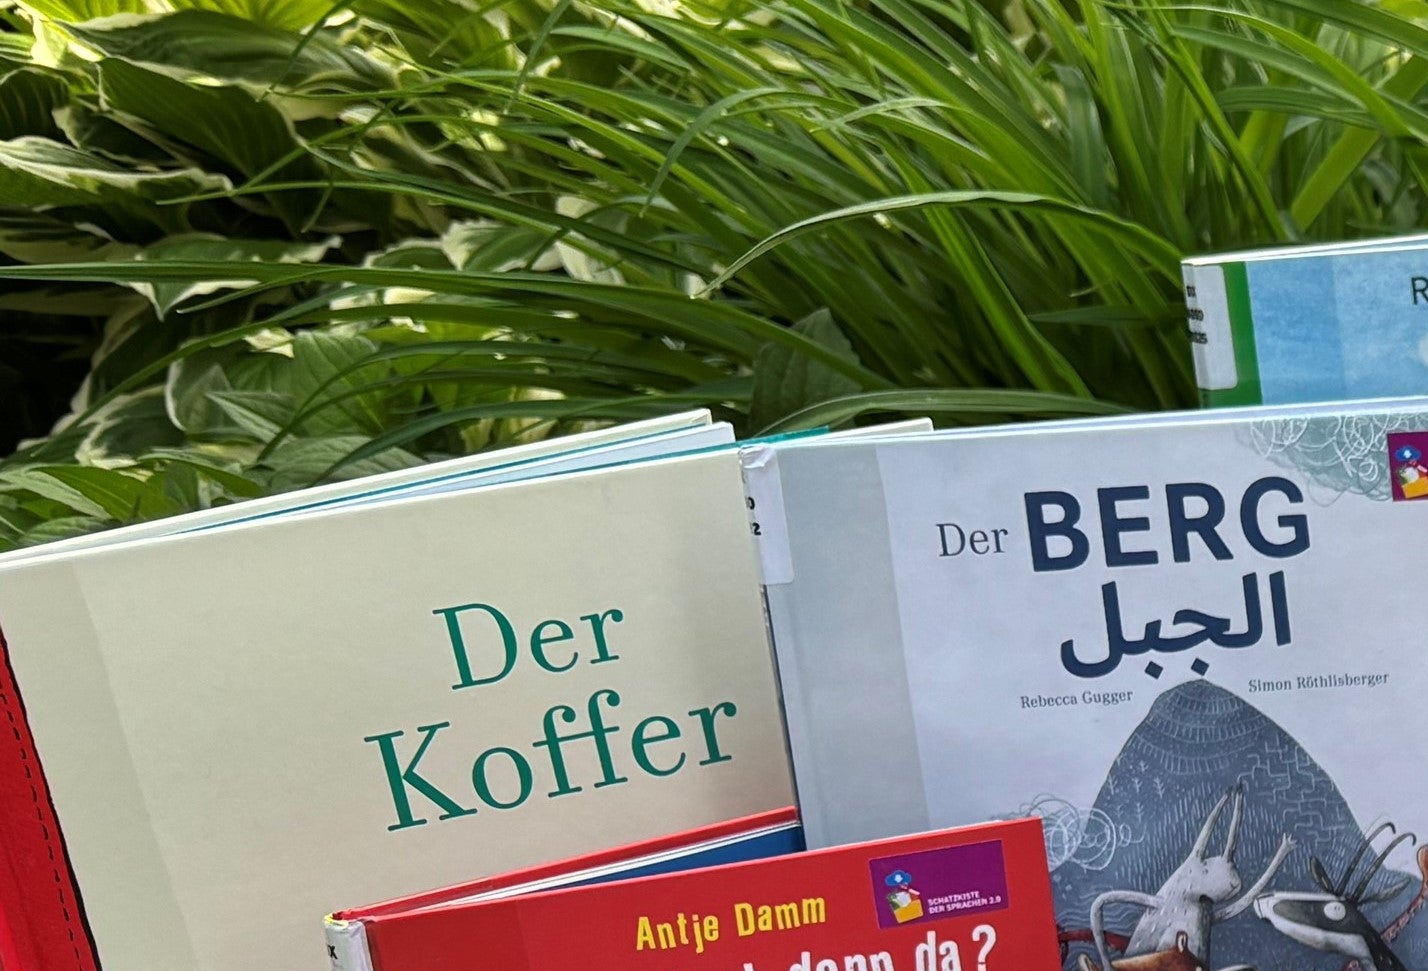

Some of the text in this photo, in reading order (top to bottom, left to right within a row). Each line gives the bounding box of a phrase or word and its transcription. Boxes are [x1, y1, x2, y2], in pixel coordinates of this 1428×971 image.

[937, 475, 1311, 572] Der BERG
[433, 602, 624, 690] Der
[1060, 572, 1293, 680] الجبل
[1020, 689, 1133, 709] Rebecca Gugger
[1248, 672, 1389, 693] Simon Röthlisberger
[364, 689, 738, 832] Koffer
[637, 896, 827, 956] Antje Damm
[928, 891, 979, 906] SCHATZKISTE
[928, 896, 1002, 914] DER SPRACHEN 2.0
